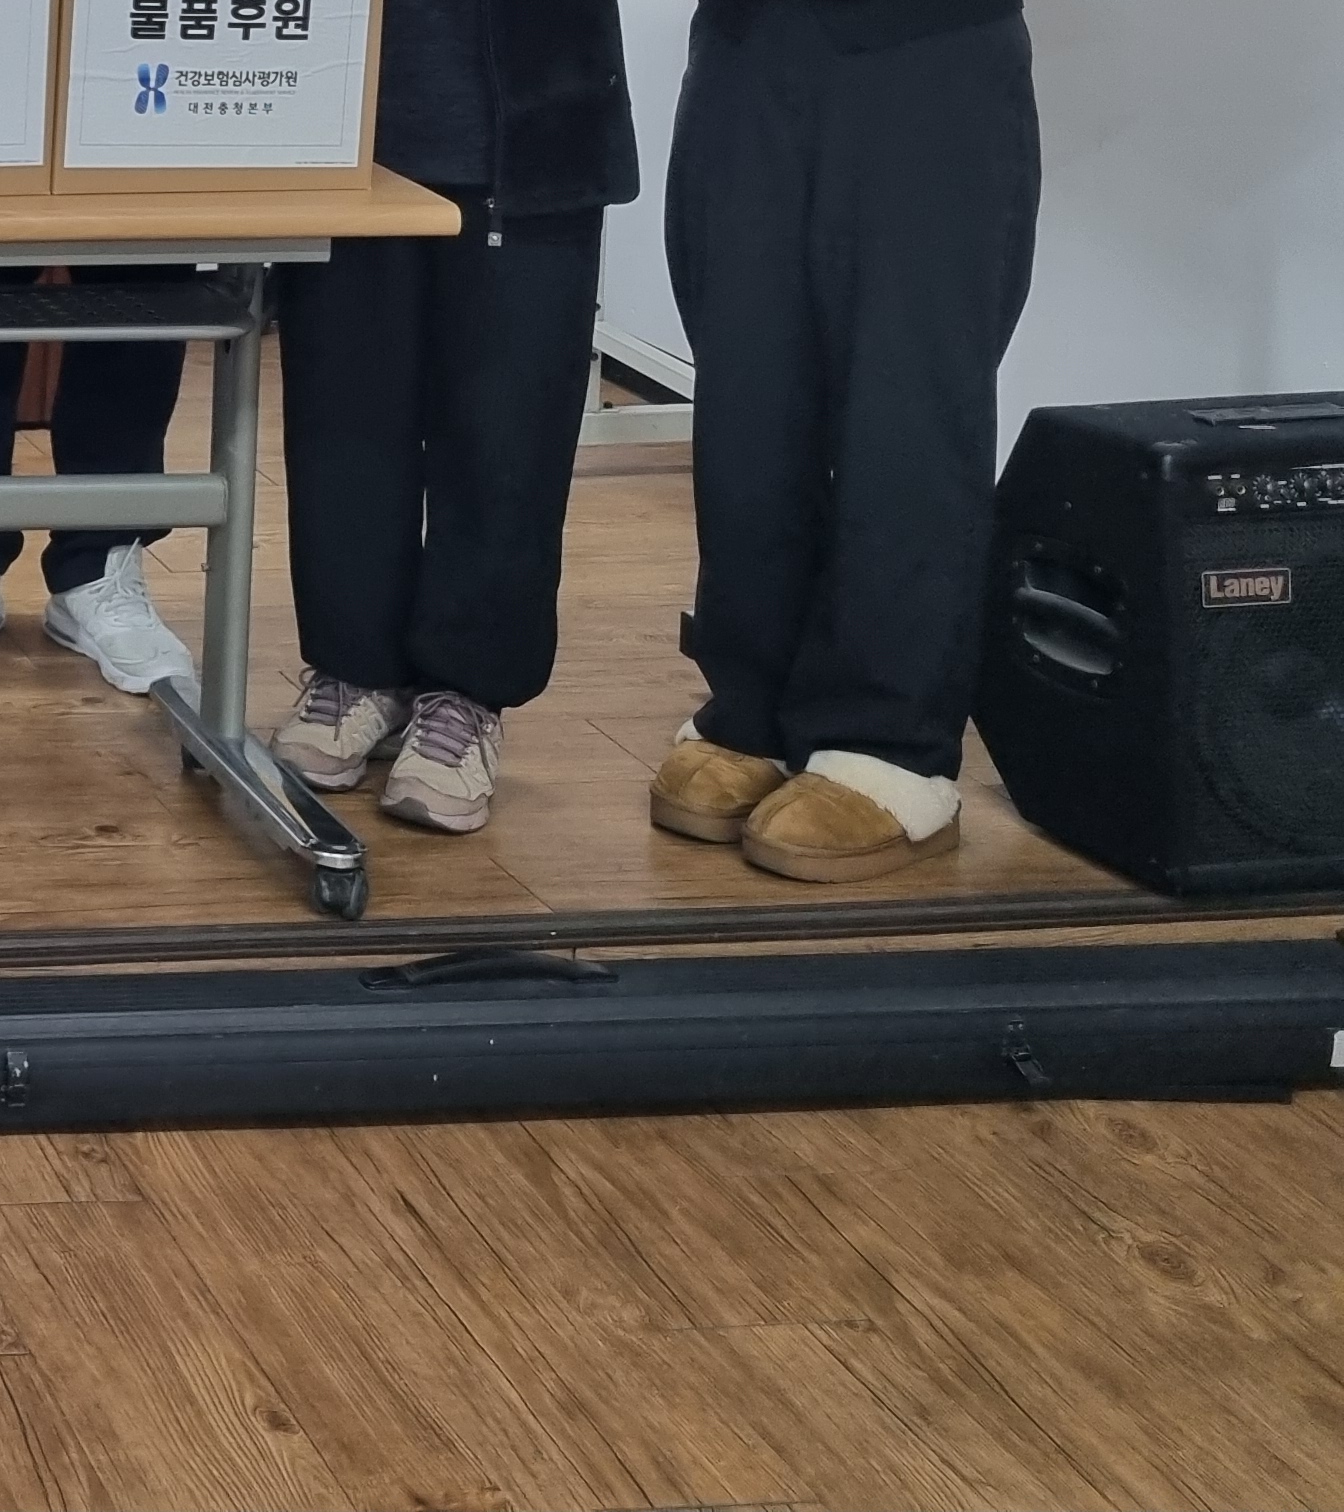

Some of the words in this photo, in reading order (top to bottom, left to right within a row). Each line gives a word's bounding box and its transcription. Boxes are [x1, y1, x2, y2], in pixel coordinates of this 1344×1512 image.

[175, 70, 298, 88] 건강보험심사평가원
[188, 101, 273, 116] 대전충청본부
[1209, 575, 1284, 601] Laney
